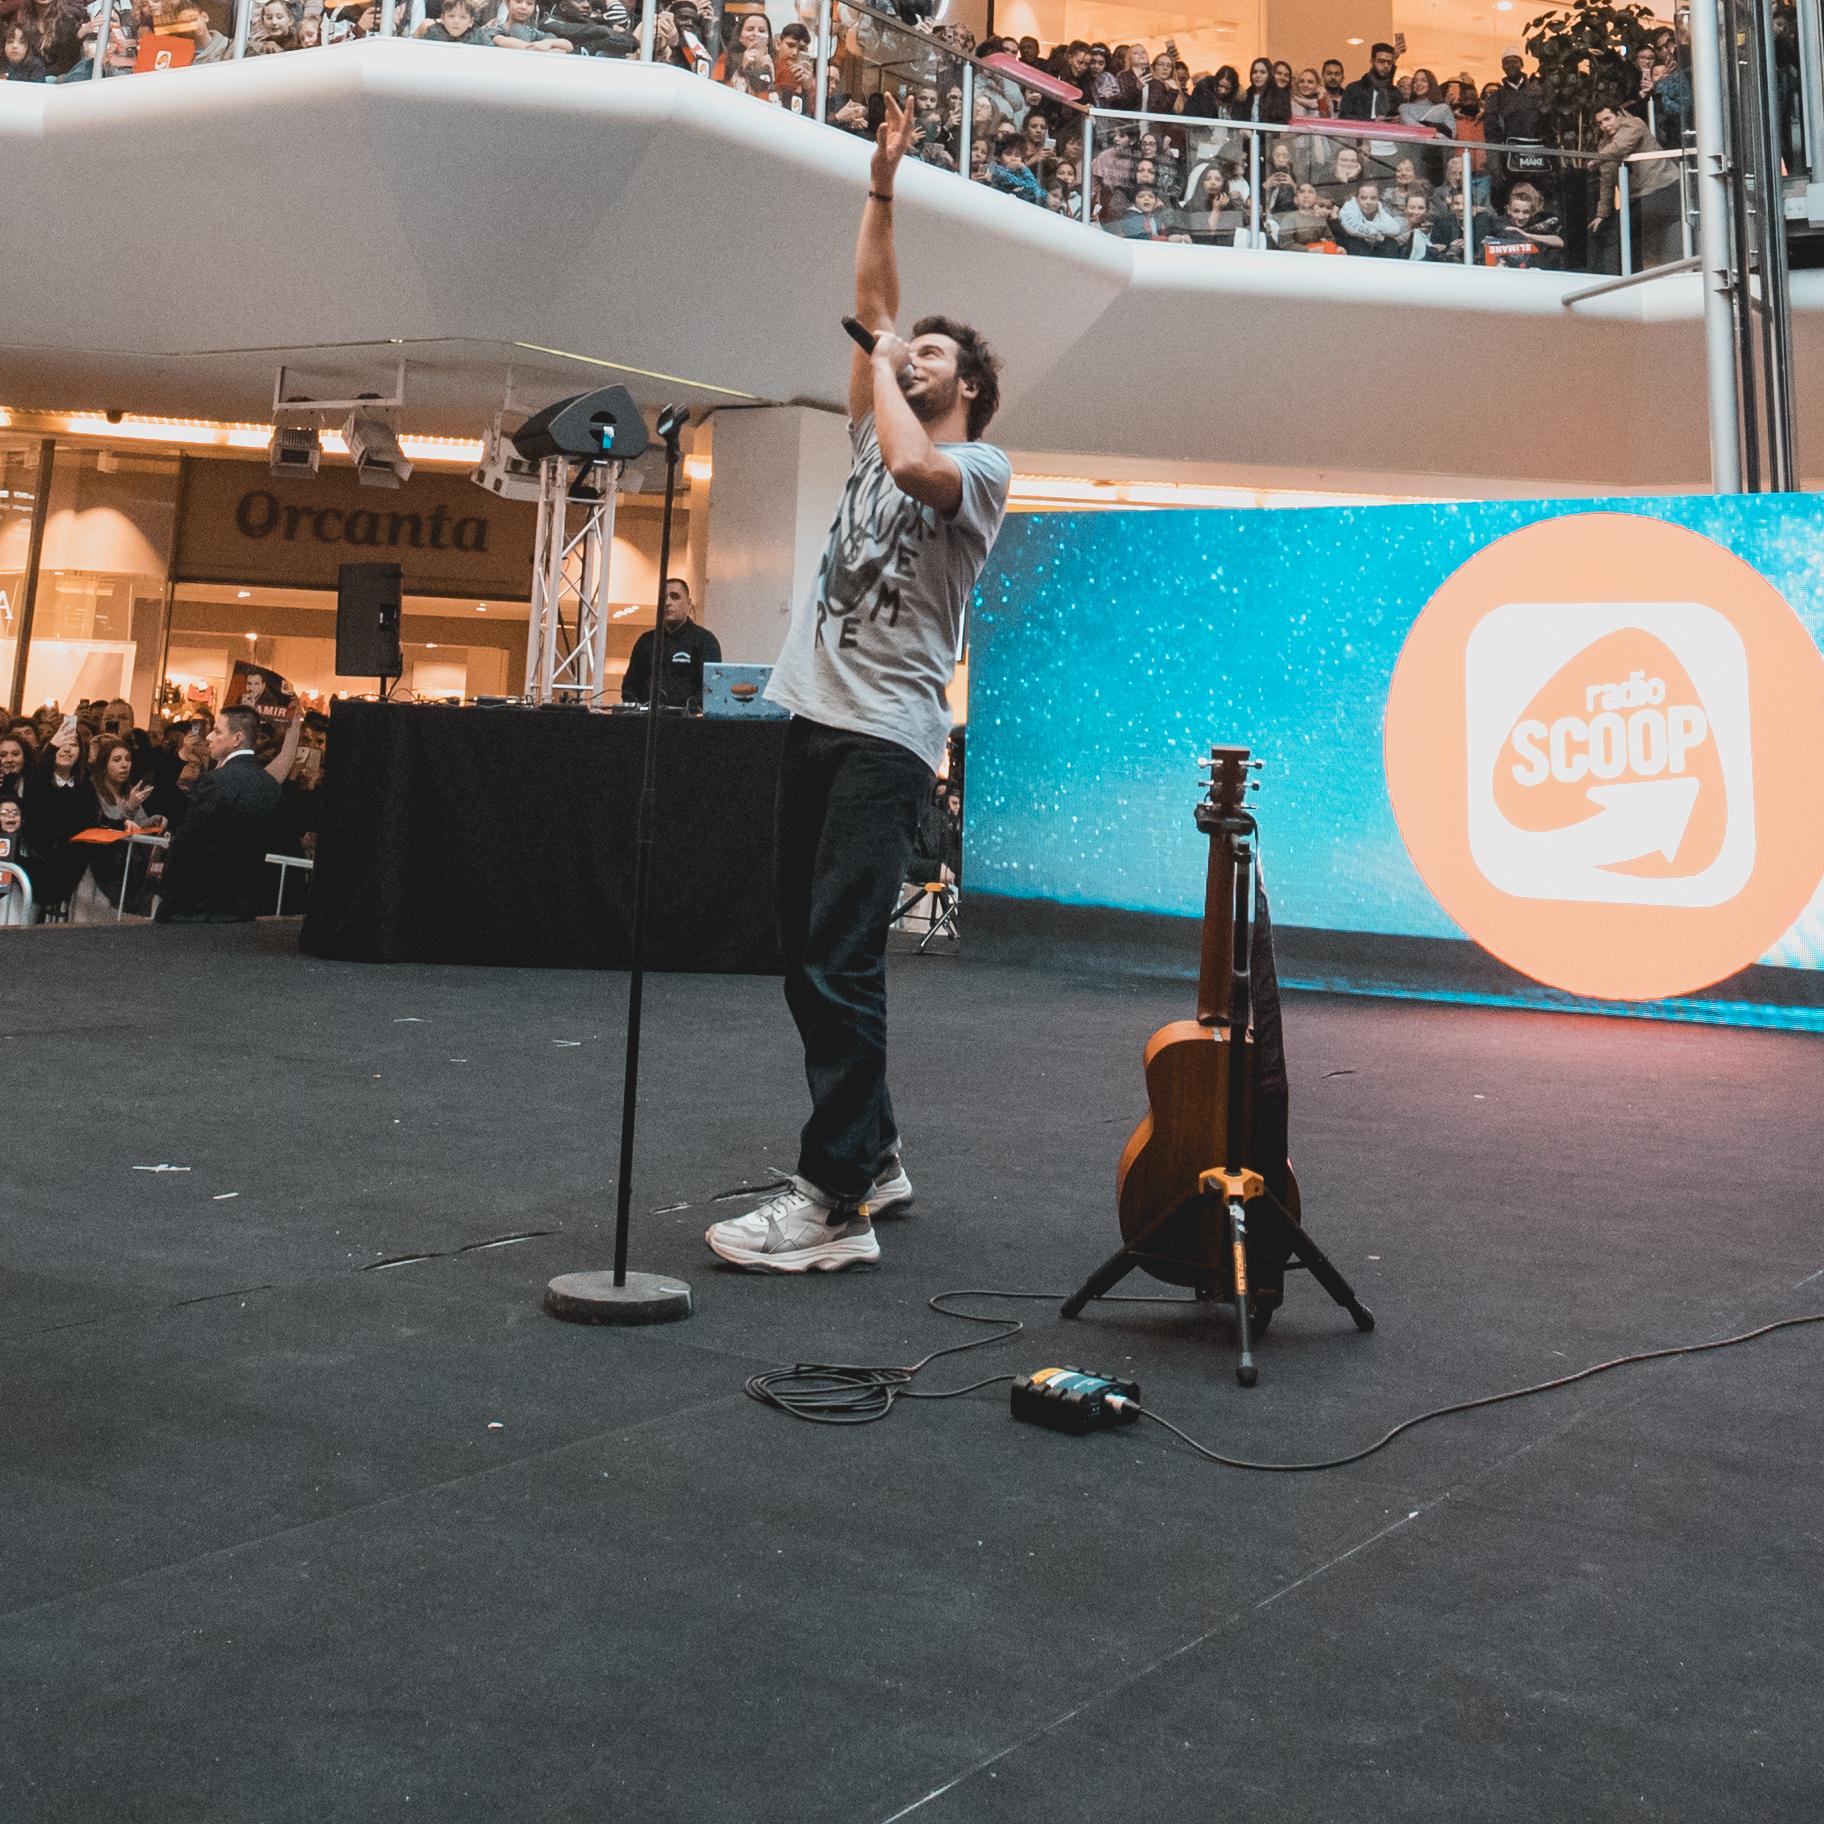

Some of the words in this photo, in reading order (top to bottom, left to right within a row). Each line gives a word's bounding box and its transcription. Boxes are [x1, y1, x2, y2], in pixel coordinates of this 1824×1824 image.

[236, 489, 491, 552] Orcanta
[256, 704, 287, 718] AMIR
[1585, 669, 1667, 712] radio
[1510, 703, 1708, 787] SCOOP
